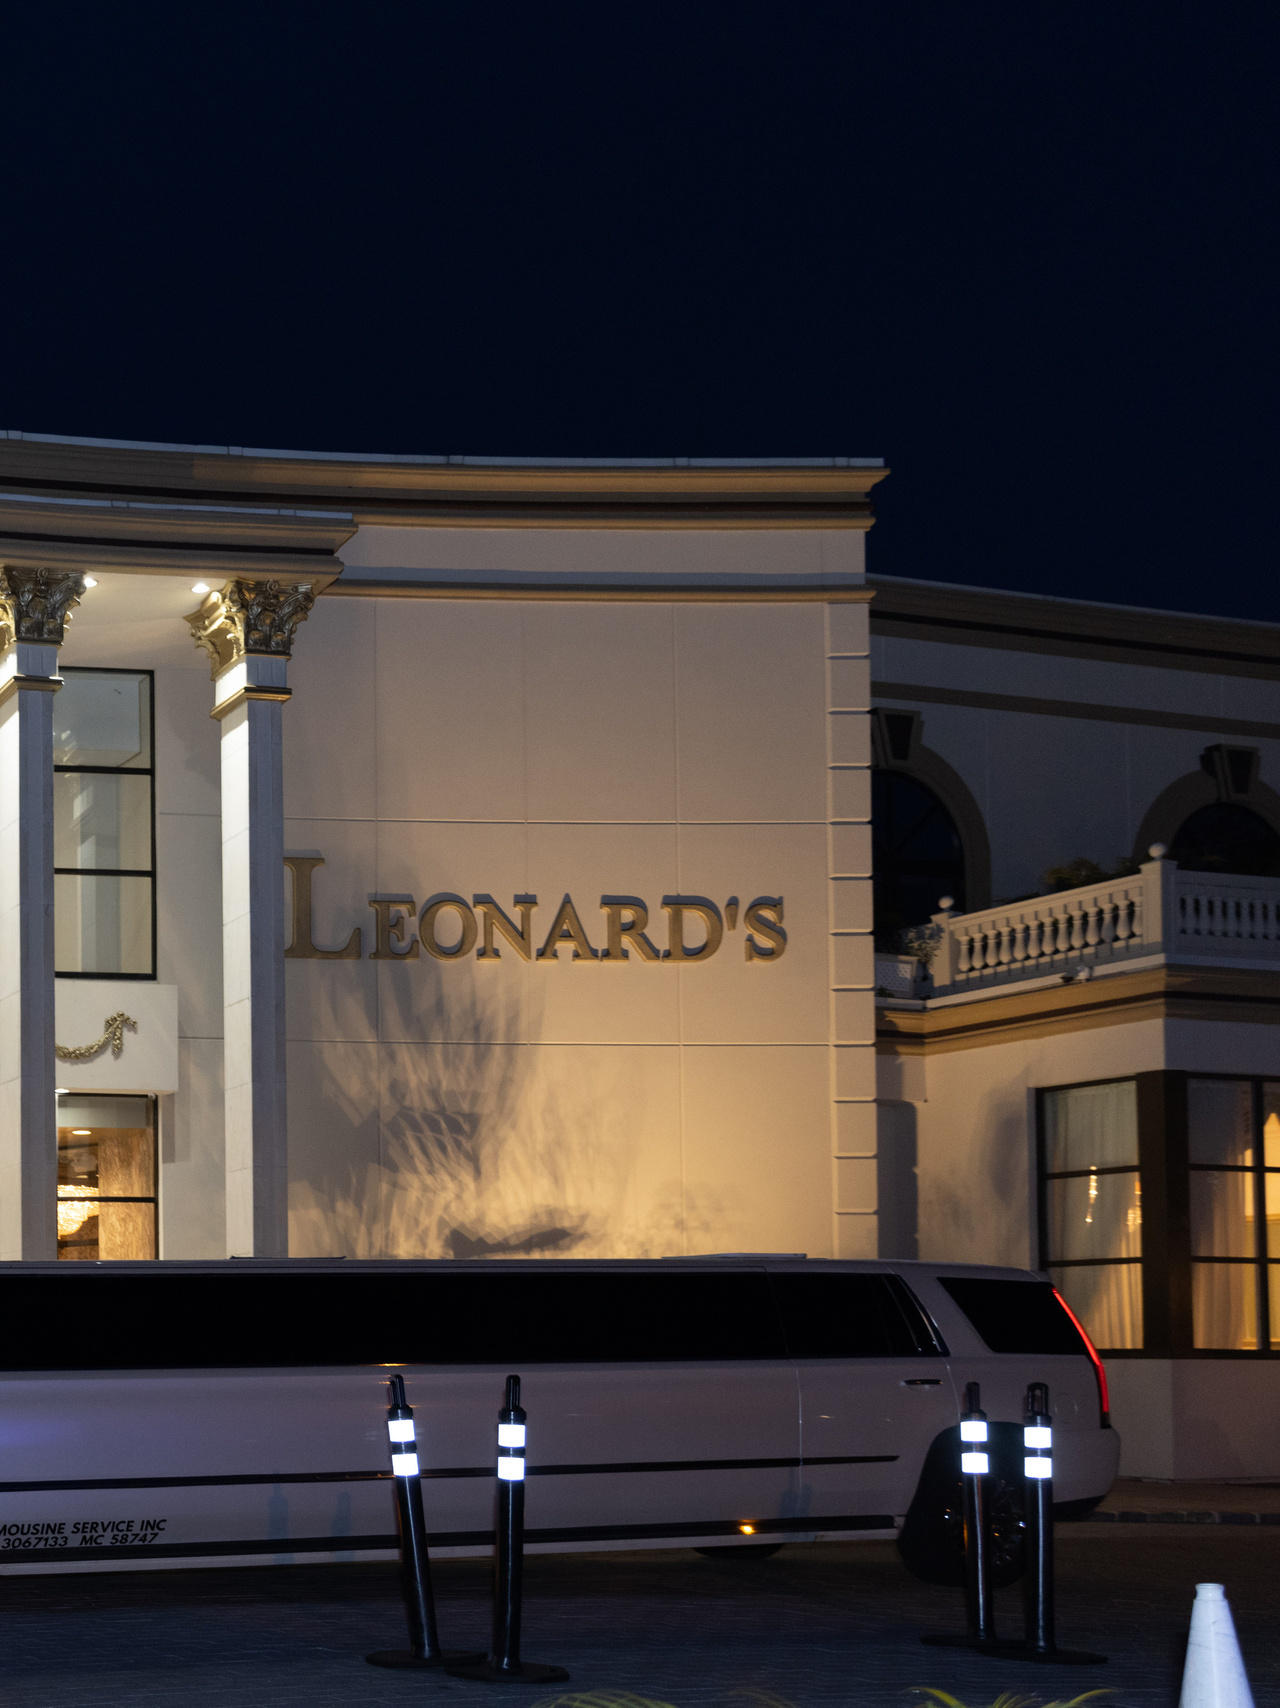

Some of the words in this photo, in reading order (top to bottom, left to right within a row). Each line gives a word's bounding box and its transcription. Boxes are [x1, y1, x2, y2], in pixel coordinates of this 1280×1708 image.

[283, 855, 787, 963] LEONARD'S
[71, 1520, 135, 1534] SERVICE
[140, 1519, 167, 1532] INC
[1, 1536, 68, 1549] 3067133
[80, 1535, 105, 1546] MC
[110, 1532, 159, 1545] 58747
